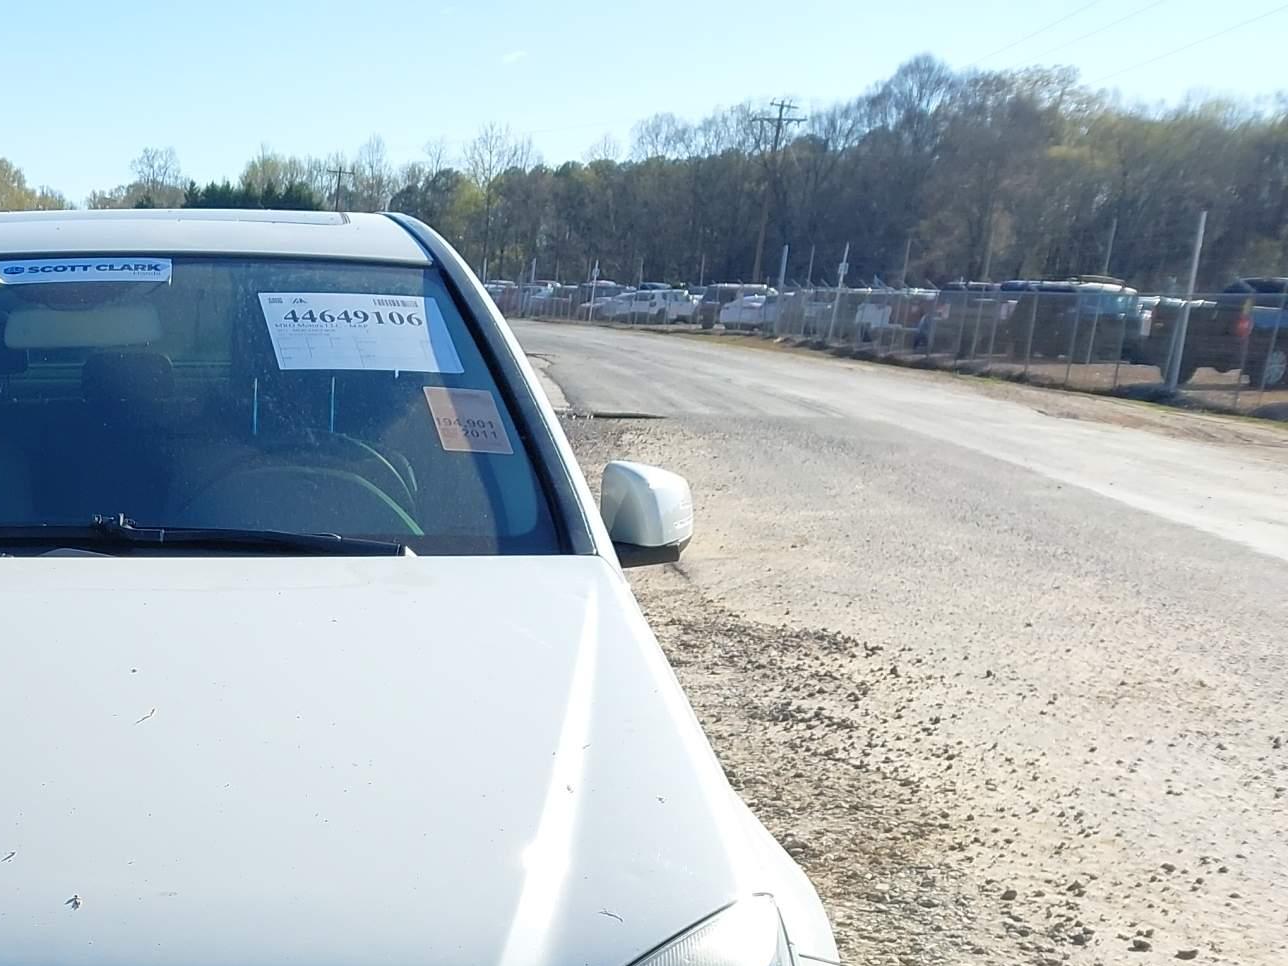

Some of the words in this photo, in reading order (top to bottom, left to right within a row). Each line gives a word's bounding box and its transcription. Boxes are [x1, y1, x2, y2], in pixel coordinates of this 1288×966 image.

[27, 264, 92, 274] SCOTT
[95, 263, 161, 272] CLARK
[283, 309, 423, 327] 44649106
[462, 428, 497, 439] 2011
